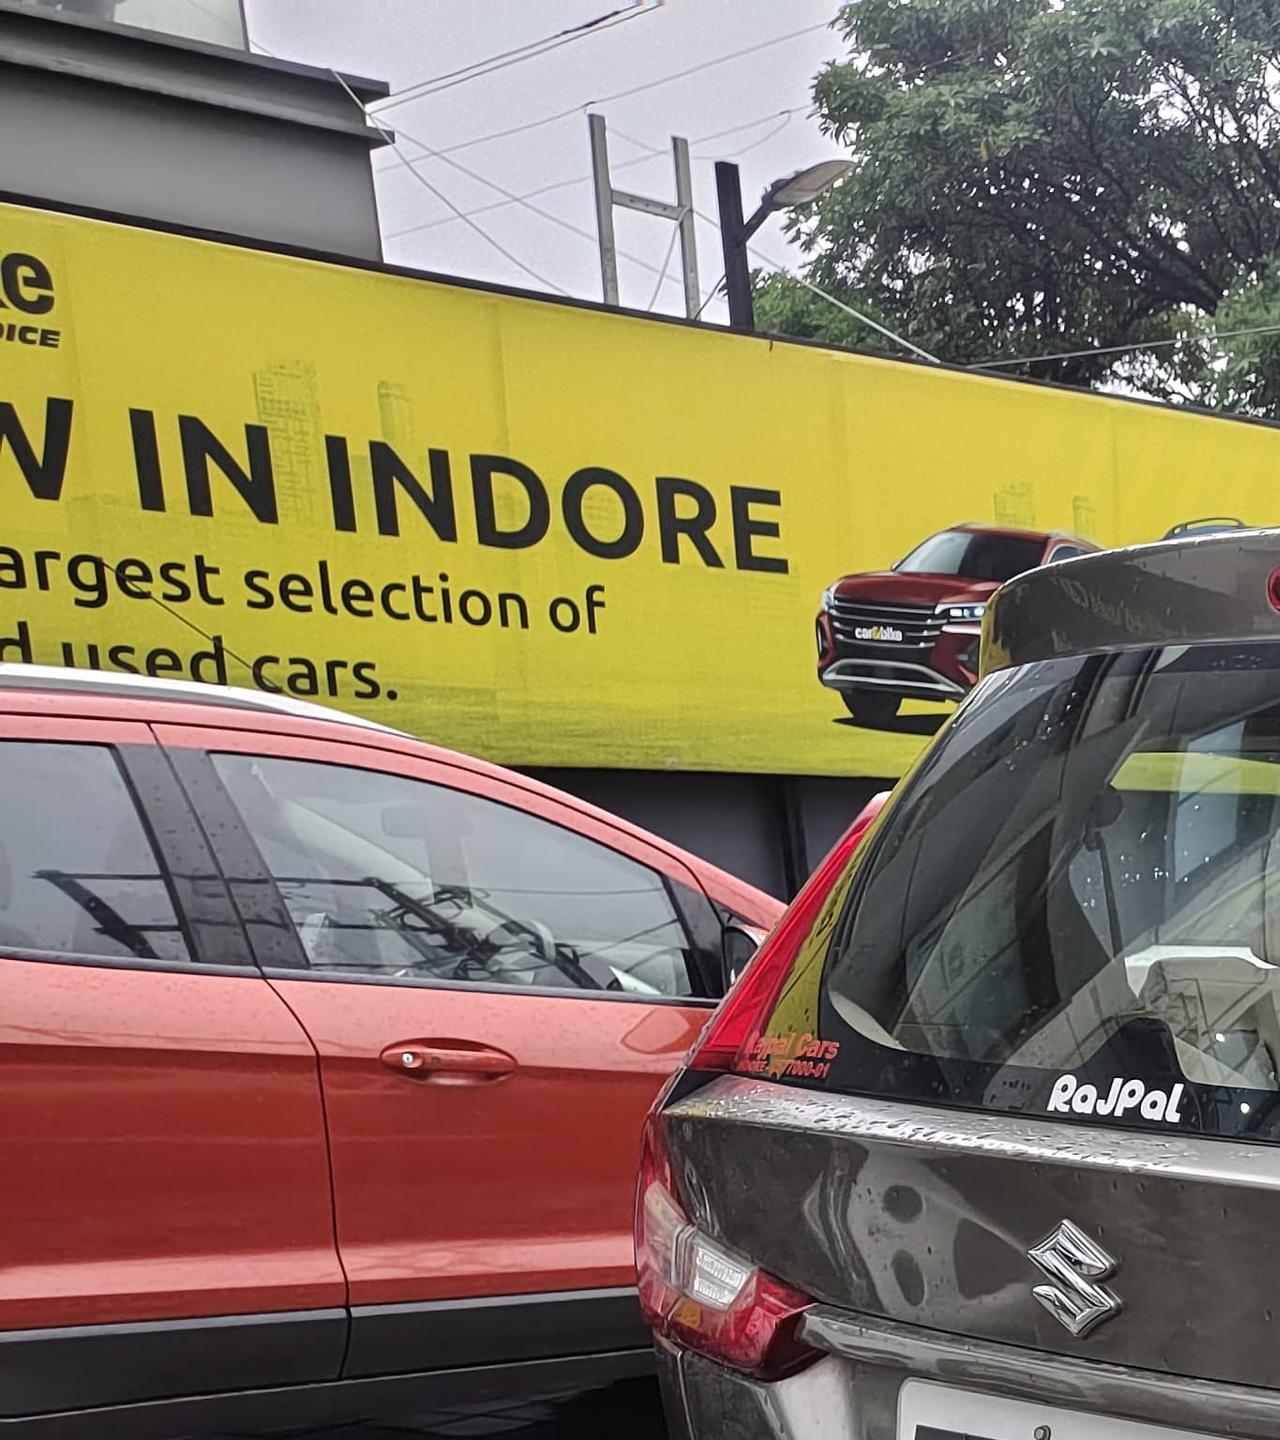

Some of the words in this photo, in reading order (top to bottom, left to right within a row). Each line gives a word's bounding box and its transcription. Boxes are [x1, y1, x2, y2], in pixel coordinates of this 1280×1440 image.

[0, 322, 61, 348] ICE
[128, 407, 279, 524] IN
[324, 434, 790, 574] INDORE
[244, 560, 530, 629] selection
[549, 585, 606, 635] of
[251, 655, 398, 701] cars.
[794, 1032, 840, 1060] Cars
